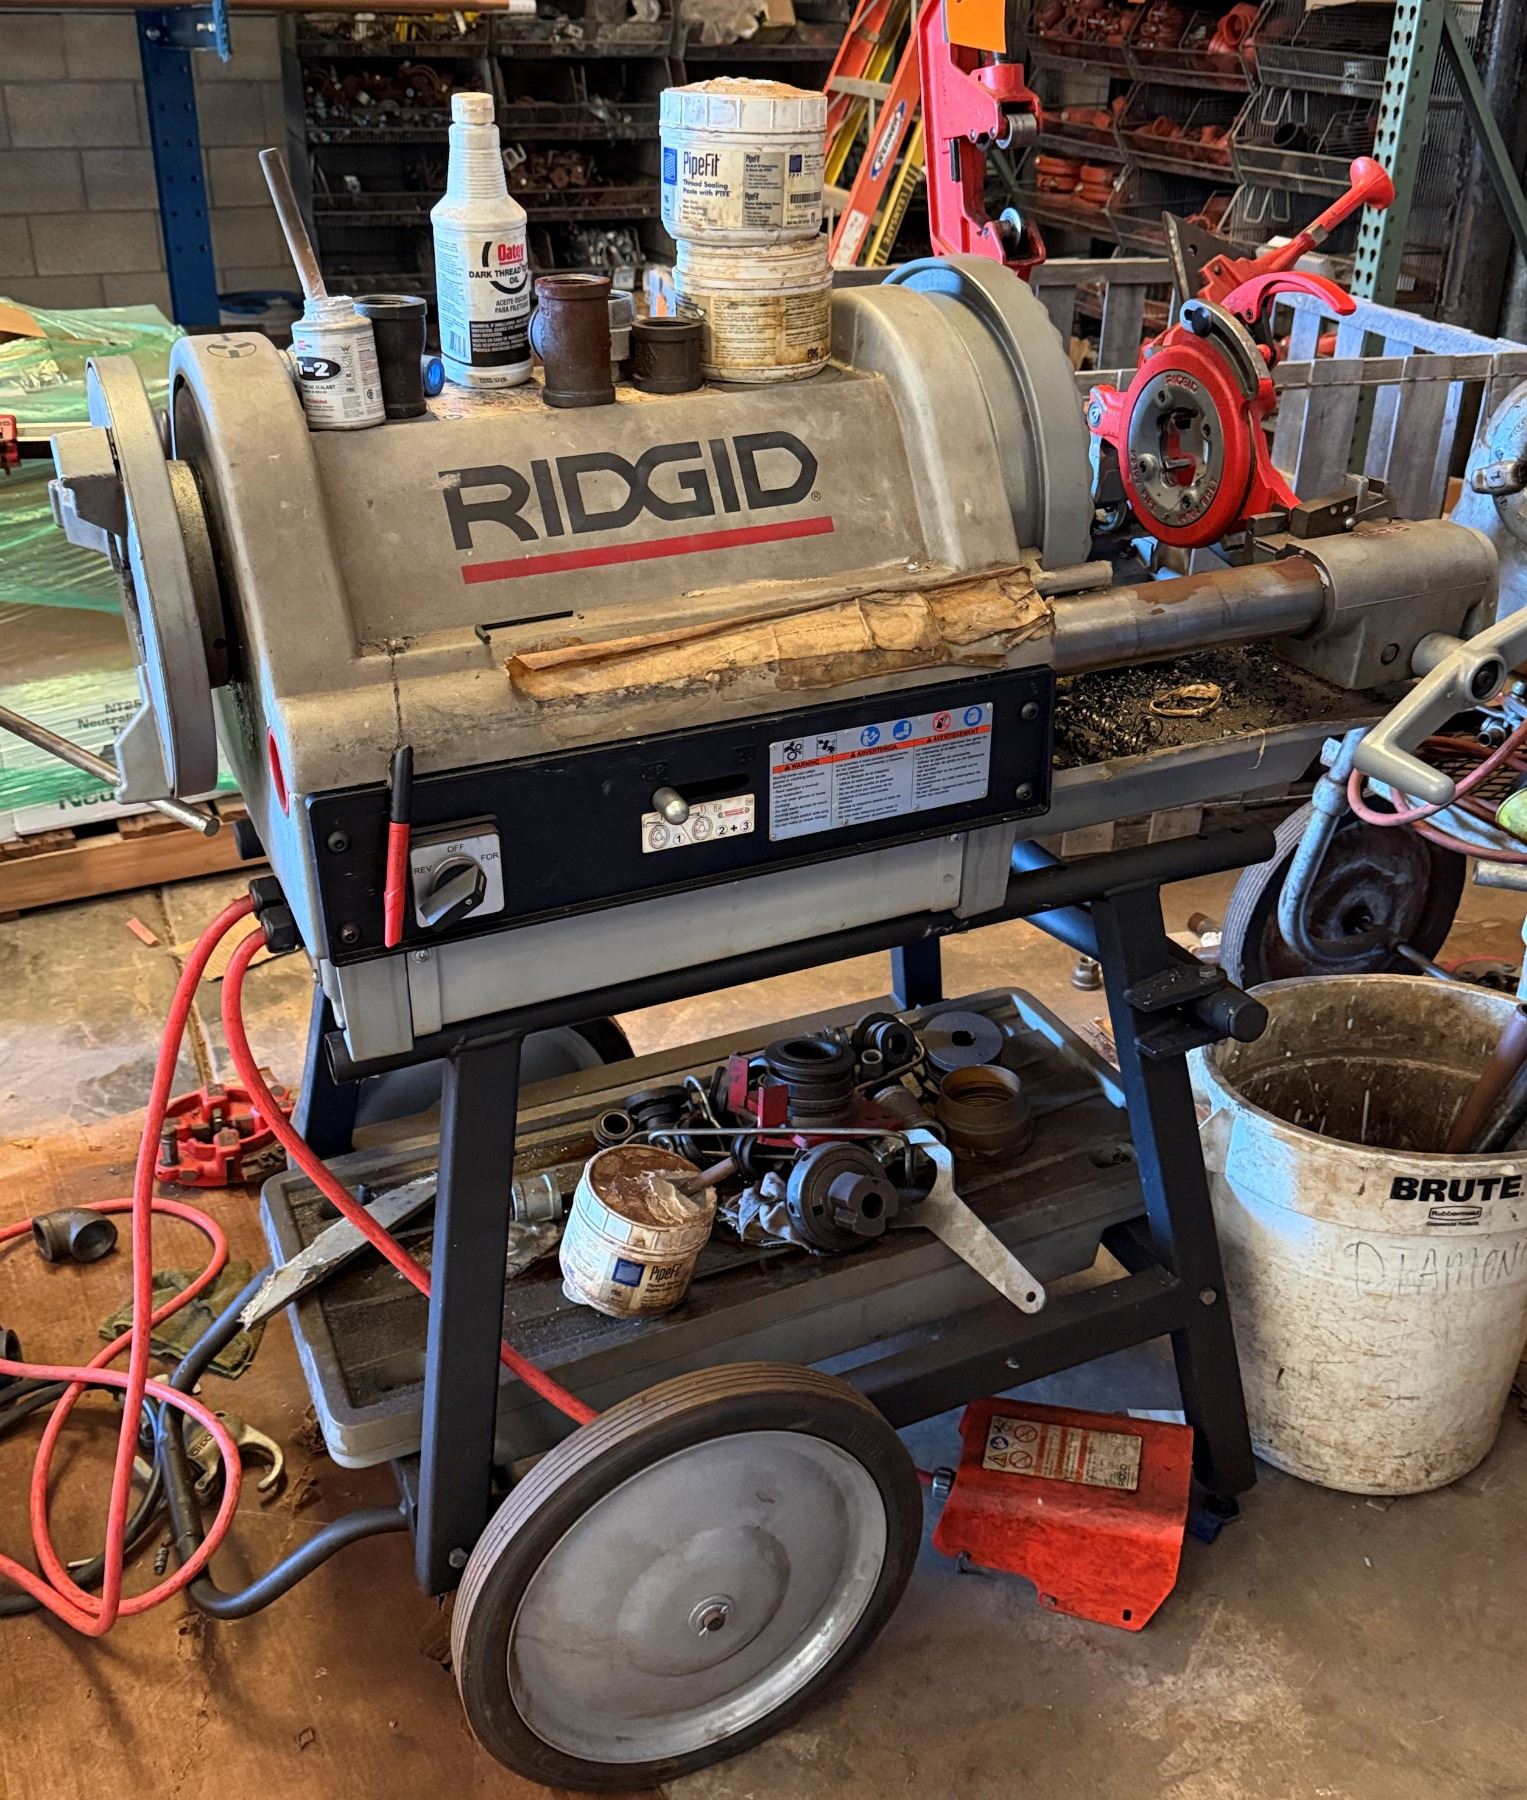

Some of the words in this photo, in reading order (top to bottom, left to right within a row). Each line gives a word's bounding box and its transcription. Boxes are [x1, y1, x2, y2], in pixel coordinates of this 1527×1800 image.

[683, 151, 721, 179] PipeFit
[683, 179, 702, 187] Thread
[703, 181, 729, 190] Sealing
[469, 271, 492, 279] DARK
[495, 267, 521, 277] THREAD
[1165, 374, 1198, 394] RIDGID
[438, 431, 818, 550] RIDGID
[792, 759, 819, 768] WARNING
[447, 843, 465, 853] OFF
[480, 851, 499, 861] FOR
[414, 865, 432, 874] REV
[1390, 1175, 1522, 1202] BRUTE
[1431, 1209, 1480, 1217] Rubbermaid
